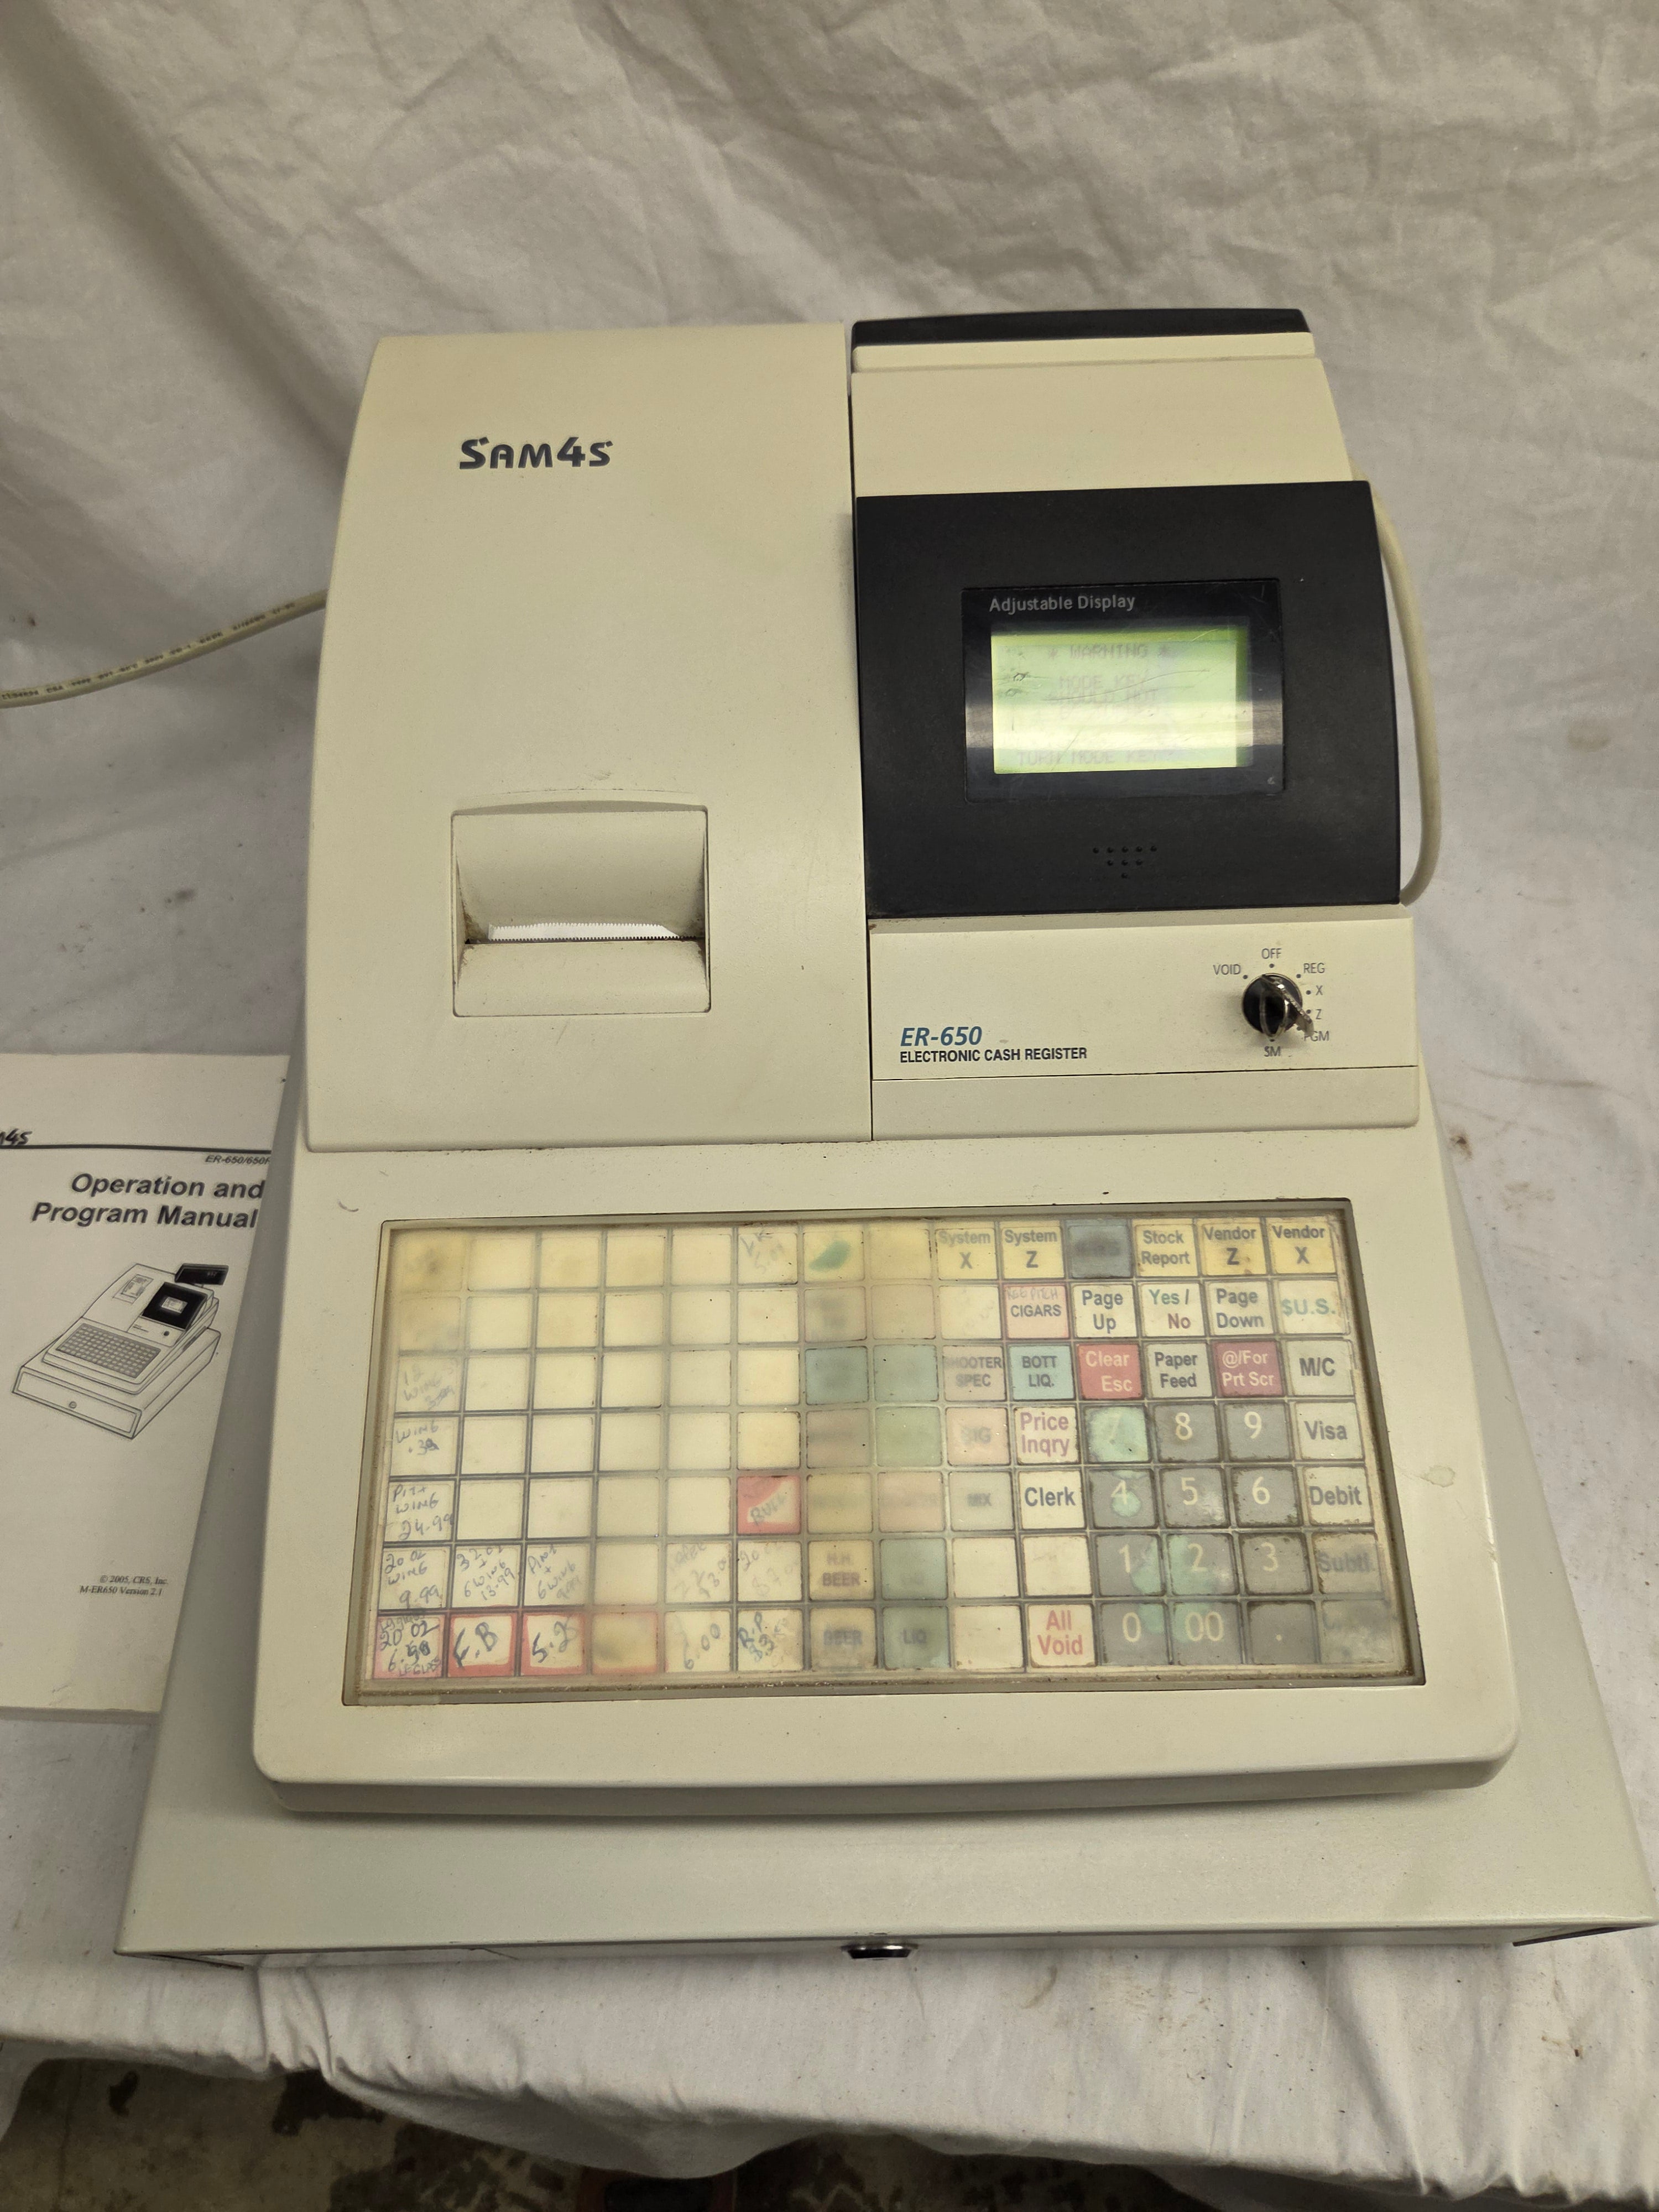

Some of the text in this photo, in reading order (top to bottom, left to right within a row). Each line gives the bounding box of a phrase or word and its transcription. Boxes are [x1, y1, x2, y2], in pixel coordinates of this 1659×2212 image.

[459, 437, 614, 469] SAM4S
[989, 594, 1135, 615] Adjustable Display
[1070, 643, 1149, 660] WARNING
[1261, 948, 1282, 959] OFF
[1213, 964, 1241, 975] VOID
[1303, 963, 1326, 974] REG
[1316, 985, 1323, 995] X
[1316, 1009, 1322, 1020] Z
[900, 1026, 982, 1046] ER-650
[900, 1047, 1087, 1063] ELECTRONIC CASH REGISTER
[1264, 1046, 1281, 1057] SM
[71, 1173, 265, 1199] Operation and
[32, 1202, 258, 1229] Program Manual
[940, 1230, 991, 1247] System
[1004, 1229, 1058, 1246] System
[1142, 1230, 1183, 1244] Stock
[1203, 1226, 1256, 1241] Vendor
[1272, 1225, 1325, 1239] Vendor
[959, 1251, 973, 1270] X
[1026, 1250, 1039, 1269] Z
[1141, 1251, 1190, 1267] Report
[1227, 1247, 1239, 1265] Z
[1296, 1246, 1310, 1265] X
[1082, 1290, 1123, 1309] Page
[1149, 1288, 1180, 1305] Yes
[1216, 1288, 1258, 1308] Page
[1010, 1304, 1062, 1317] CIGARS
[1281, 1297, 1336, 1316] $U.S.
[1092, 1314, 1117, 1333] Up
[1167, 1313, 1191, 1329] No
[1217, 1312, 1265, 1328] Down
[1022, 1355, 1057, 1369] BOTT
[1085, 1350, 1130, 1367] Clear
[1155, 1352, 1197, 1368] Paper
[1299, 1357, 1335, 1377] M/C
[956, 1373, 992, 1387] SPEC
[1101, 1375, 1133, 1392] Esc
[1160, 1373, 1197, 1388] Feed
[1221, 1371, 1275, 1387] Prt Scr
[1020, 1411, 1069, 1431] Price
[1175, 1412, 1193, 1441] 8
[1244, 1411, 1262, 1439] 9
[1304, 1420, 1347, 1441] Visa
[1021, 1437, 1070, 1458] Inqry
[1024, 1486, 1076, 1506] Clerk
[1111, 1479, 1128, 1505] 4
[1181, 1477, 1199, 1506] 5
[1251, 1476, 1270, 1505] 6
[1309, 1485, 1362, 1506] Debit
[1119, 1543, 1131, 1573] 1
[1187, 1543, 1207, 1572] 2
[1260, 1542, 1279, 1572] 3
[120, 1587, 149, 1596] Version
[150, 1588, 163, 1597] 2.1
[1046, 1609, 1072, 1631] All
[1121, 1611, 1141, 1643] 0
[1184, 1611, 1225, 1642] 00
[1037, 1634, 1084, 1656] Void
